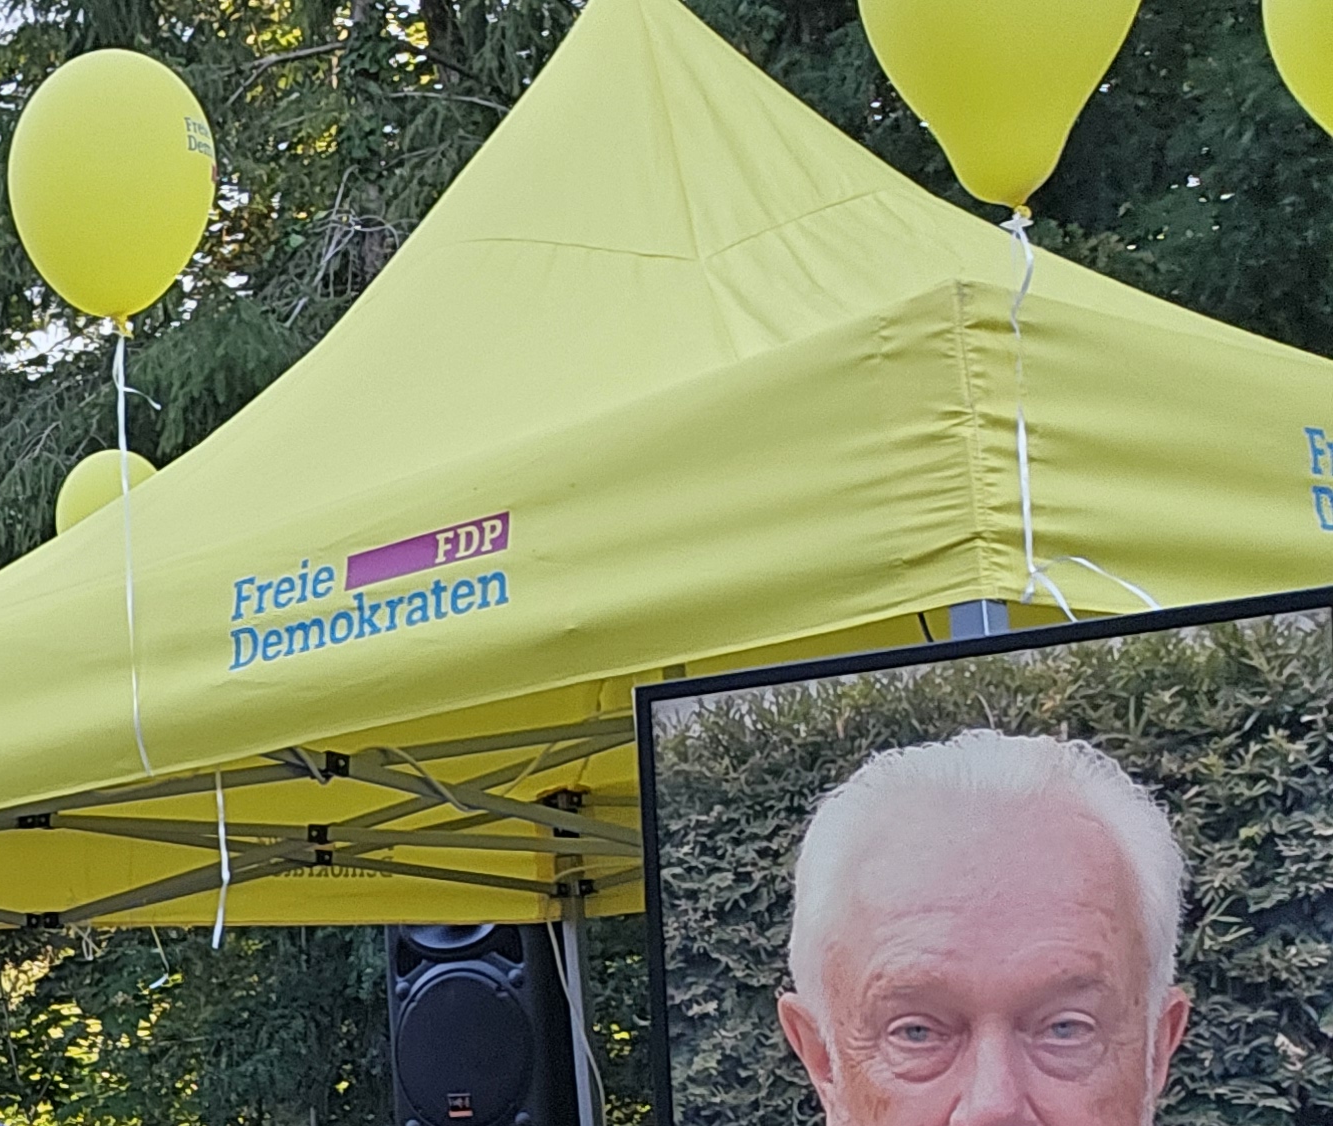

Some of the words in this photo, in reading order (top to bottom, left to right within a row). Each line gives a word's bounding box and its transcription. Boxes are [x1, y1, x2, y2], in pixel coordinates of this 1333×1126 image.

[434, 519, 503, 564] FDP
[229, 570, 509, 671] Demokraten
[231, 559, 335, 621] Freie
